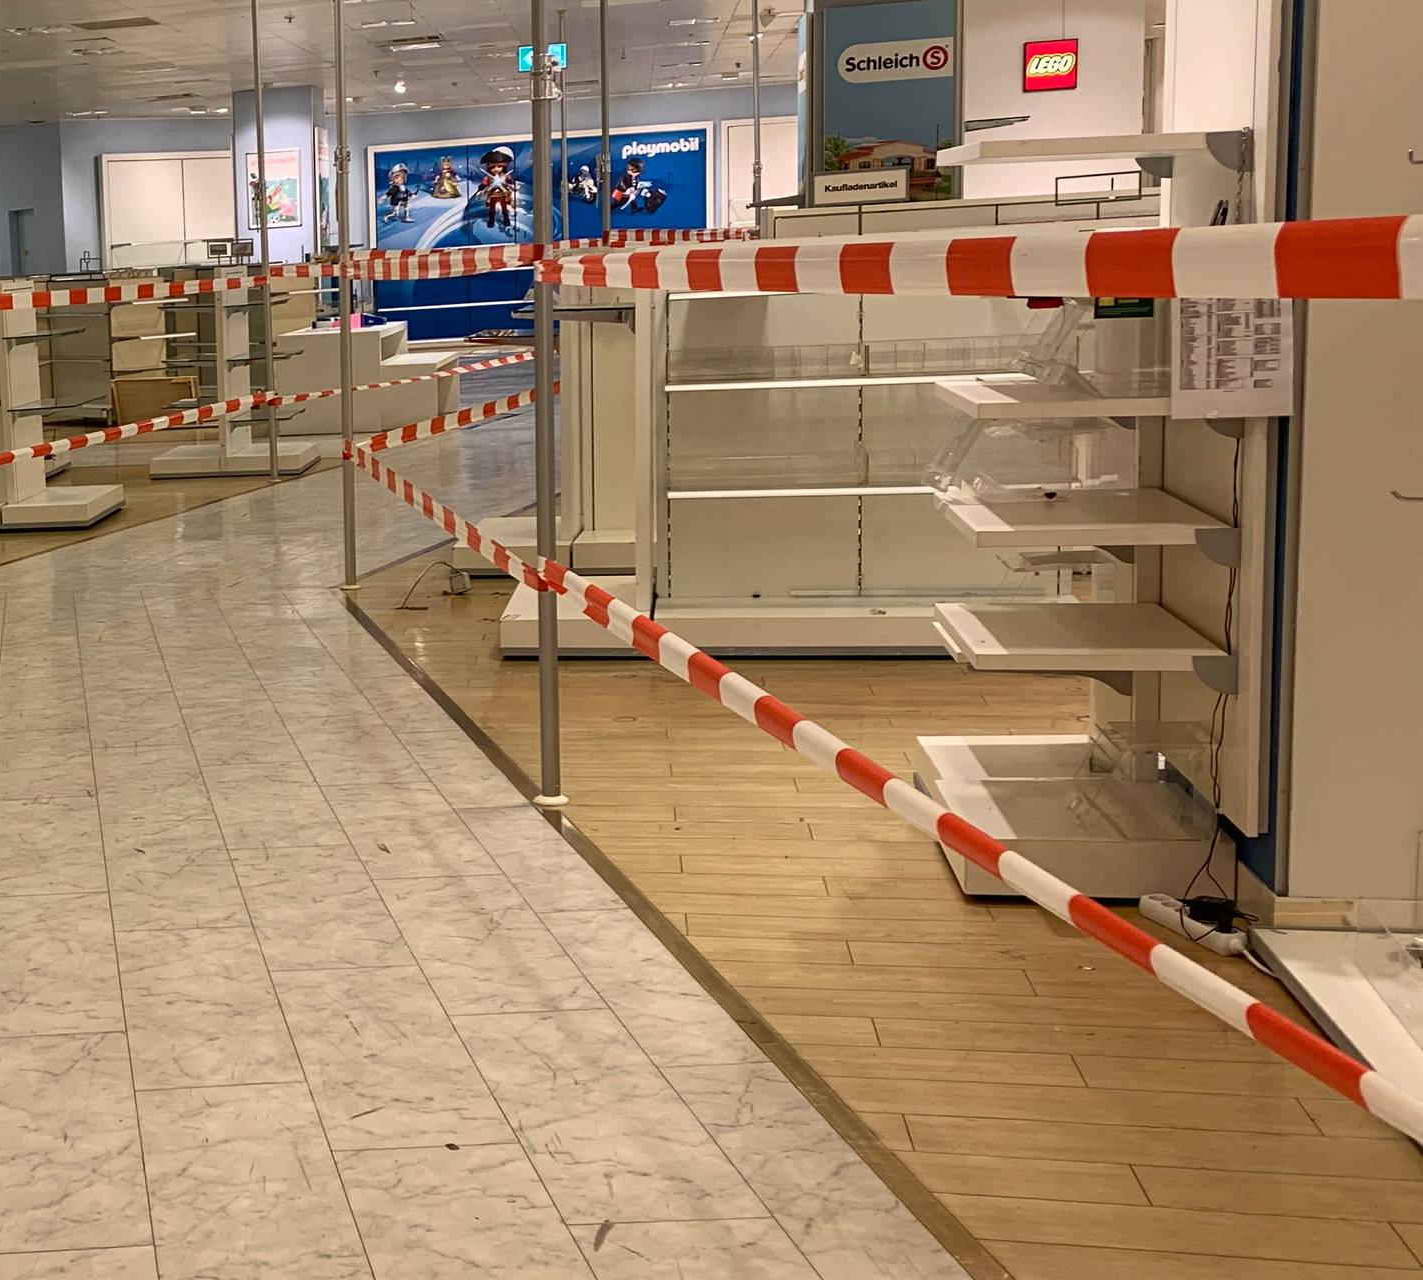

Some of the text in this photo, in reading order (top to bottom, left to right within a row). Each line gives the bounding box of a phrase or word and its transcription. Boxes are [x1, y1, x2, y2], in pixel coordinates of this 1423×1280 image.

[845, 53, 920, 72] Schleich
[1028, 54, 1074, 76] LEGO
[621, 137, 699, 159] playmobil
[824, 180, 898, 192] Kaufladenartikel
